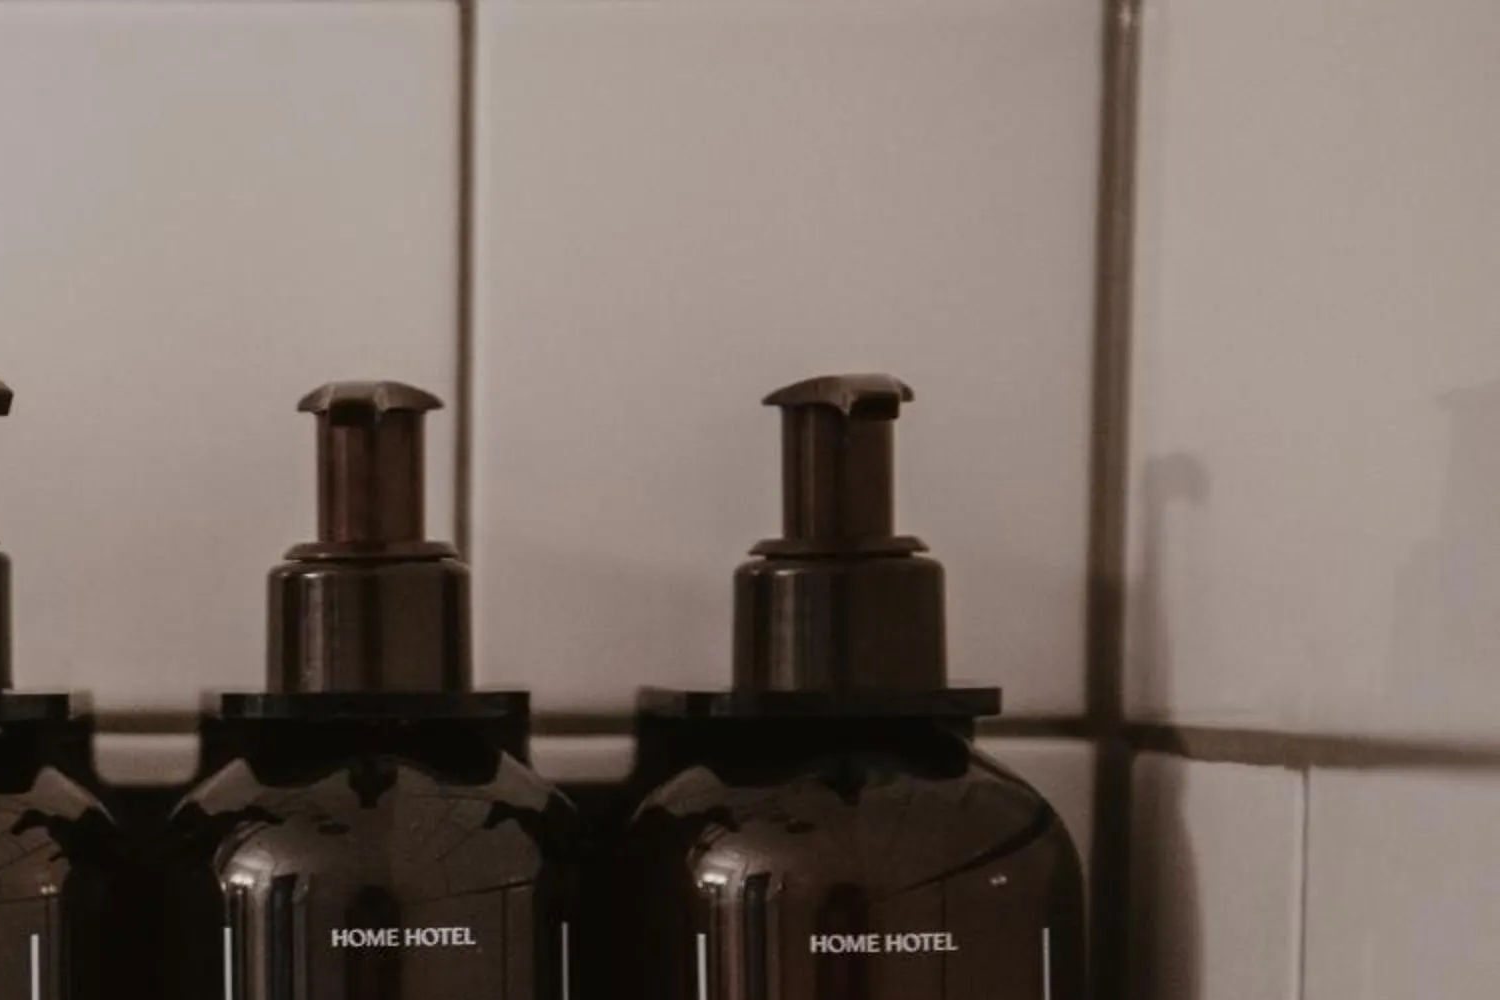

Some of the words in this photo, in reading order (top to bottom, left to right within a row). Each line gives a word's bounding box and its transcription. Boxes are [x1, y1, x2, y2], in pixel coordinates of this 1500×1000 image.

[332, 928, 399, 948] HOME
[404, 927, 476, 948] HOTEL
[810, 934, 880, 954] HOME
[885, 933, 958, 953] HOTEL
